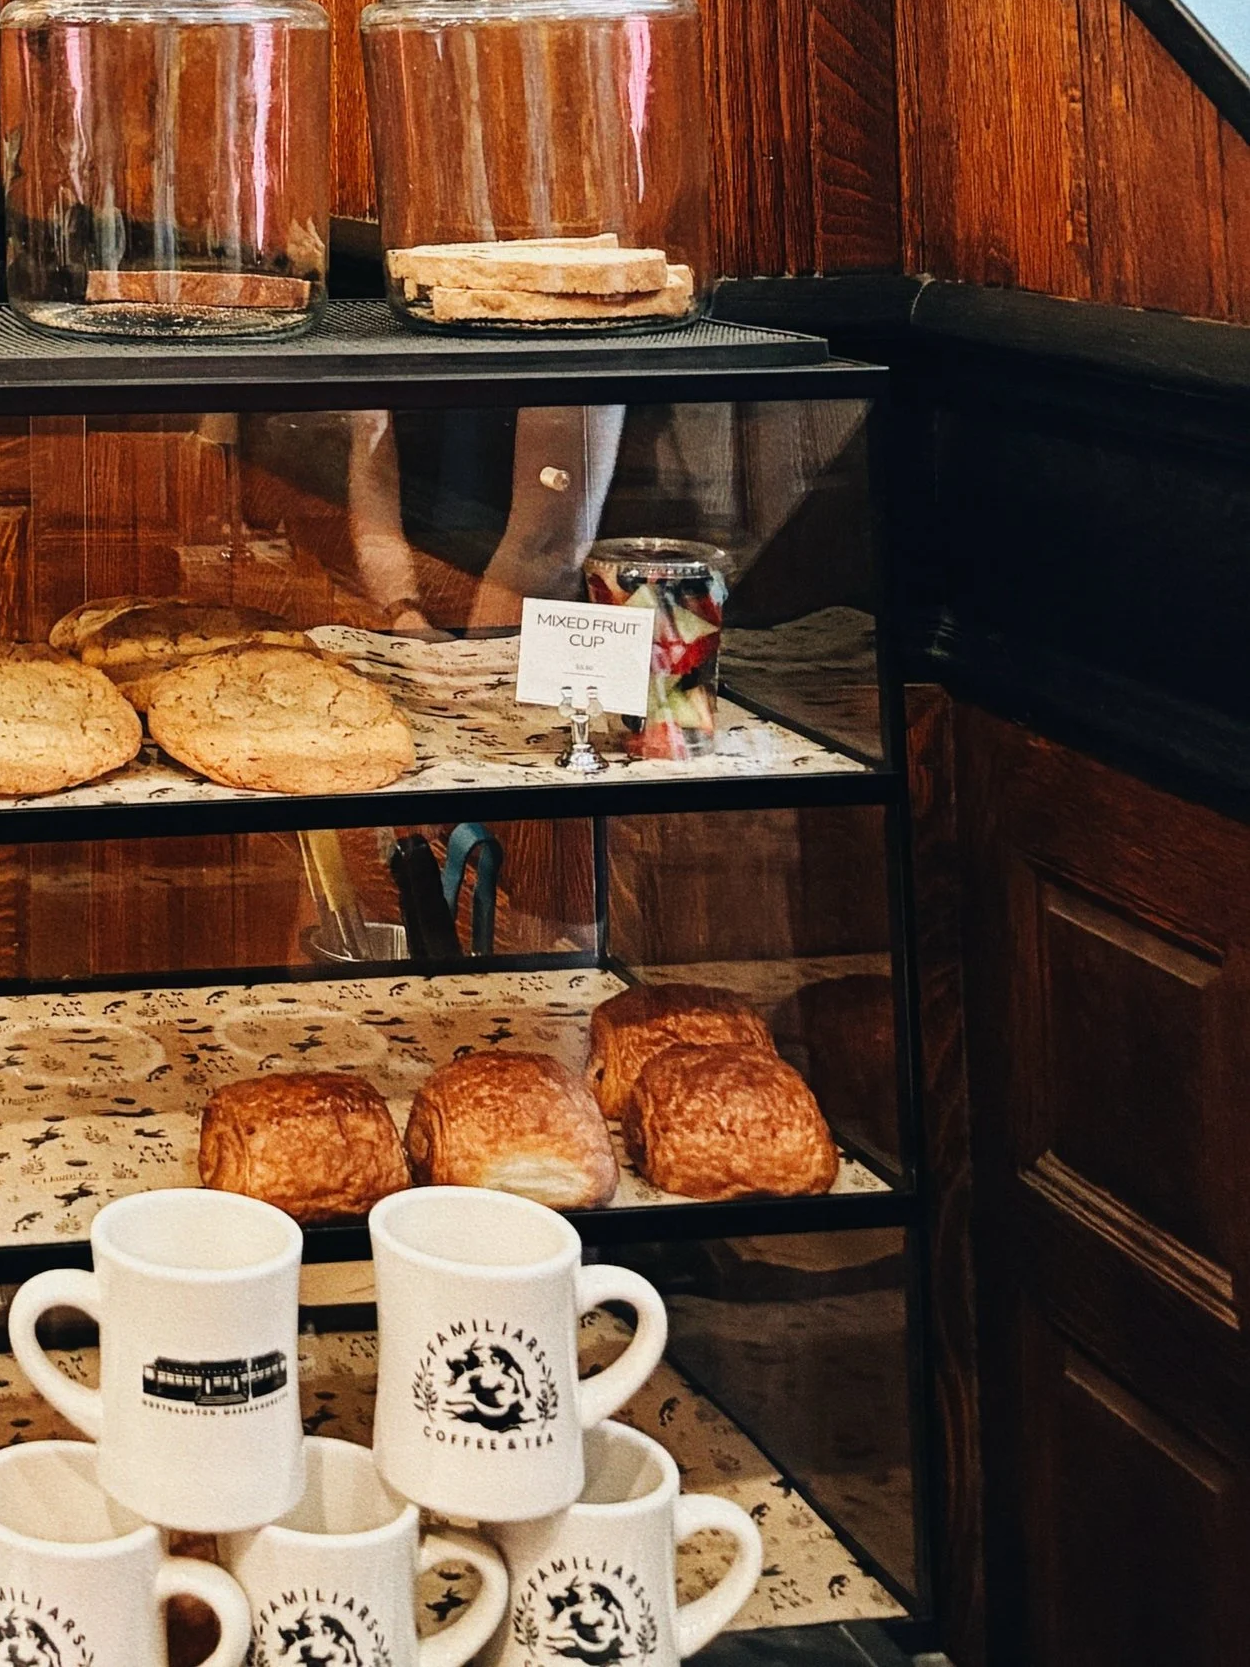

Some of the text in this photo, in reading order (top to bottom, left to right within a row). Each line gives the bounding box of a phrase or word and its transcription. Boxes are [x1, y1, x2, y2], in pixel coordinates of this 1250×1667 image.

[537, 613, 641, 635] MIXED FRUIT
[569, 634, 605, 648] CUP
[426, 1318, 546, 1364] FAMILIARS
[422, 1425, 554, 1451] COFFEE & TEA
[528, 1556, 646, 1599] FAMILIARS
[259, 1587, 379, 1633] FAMILIARS
